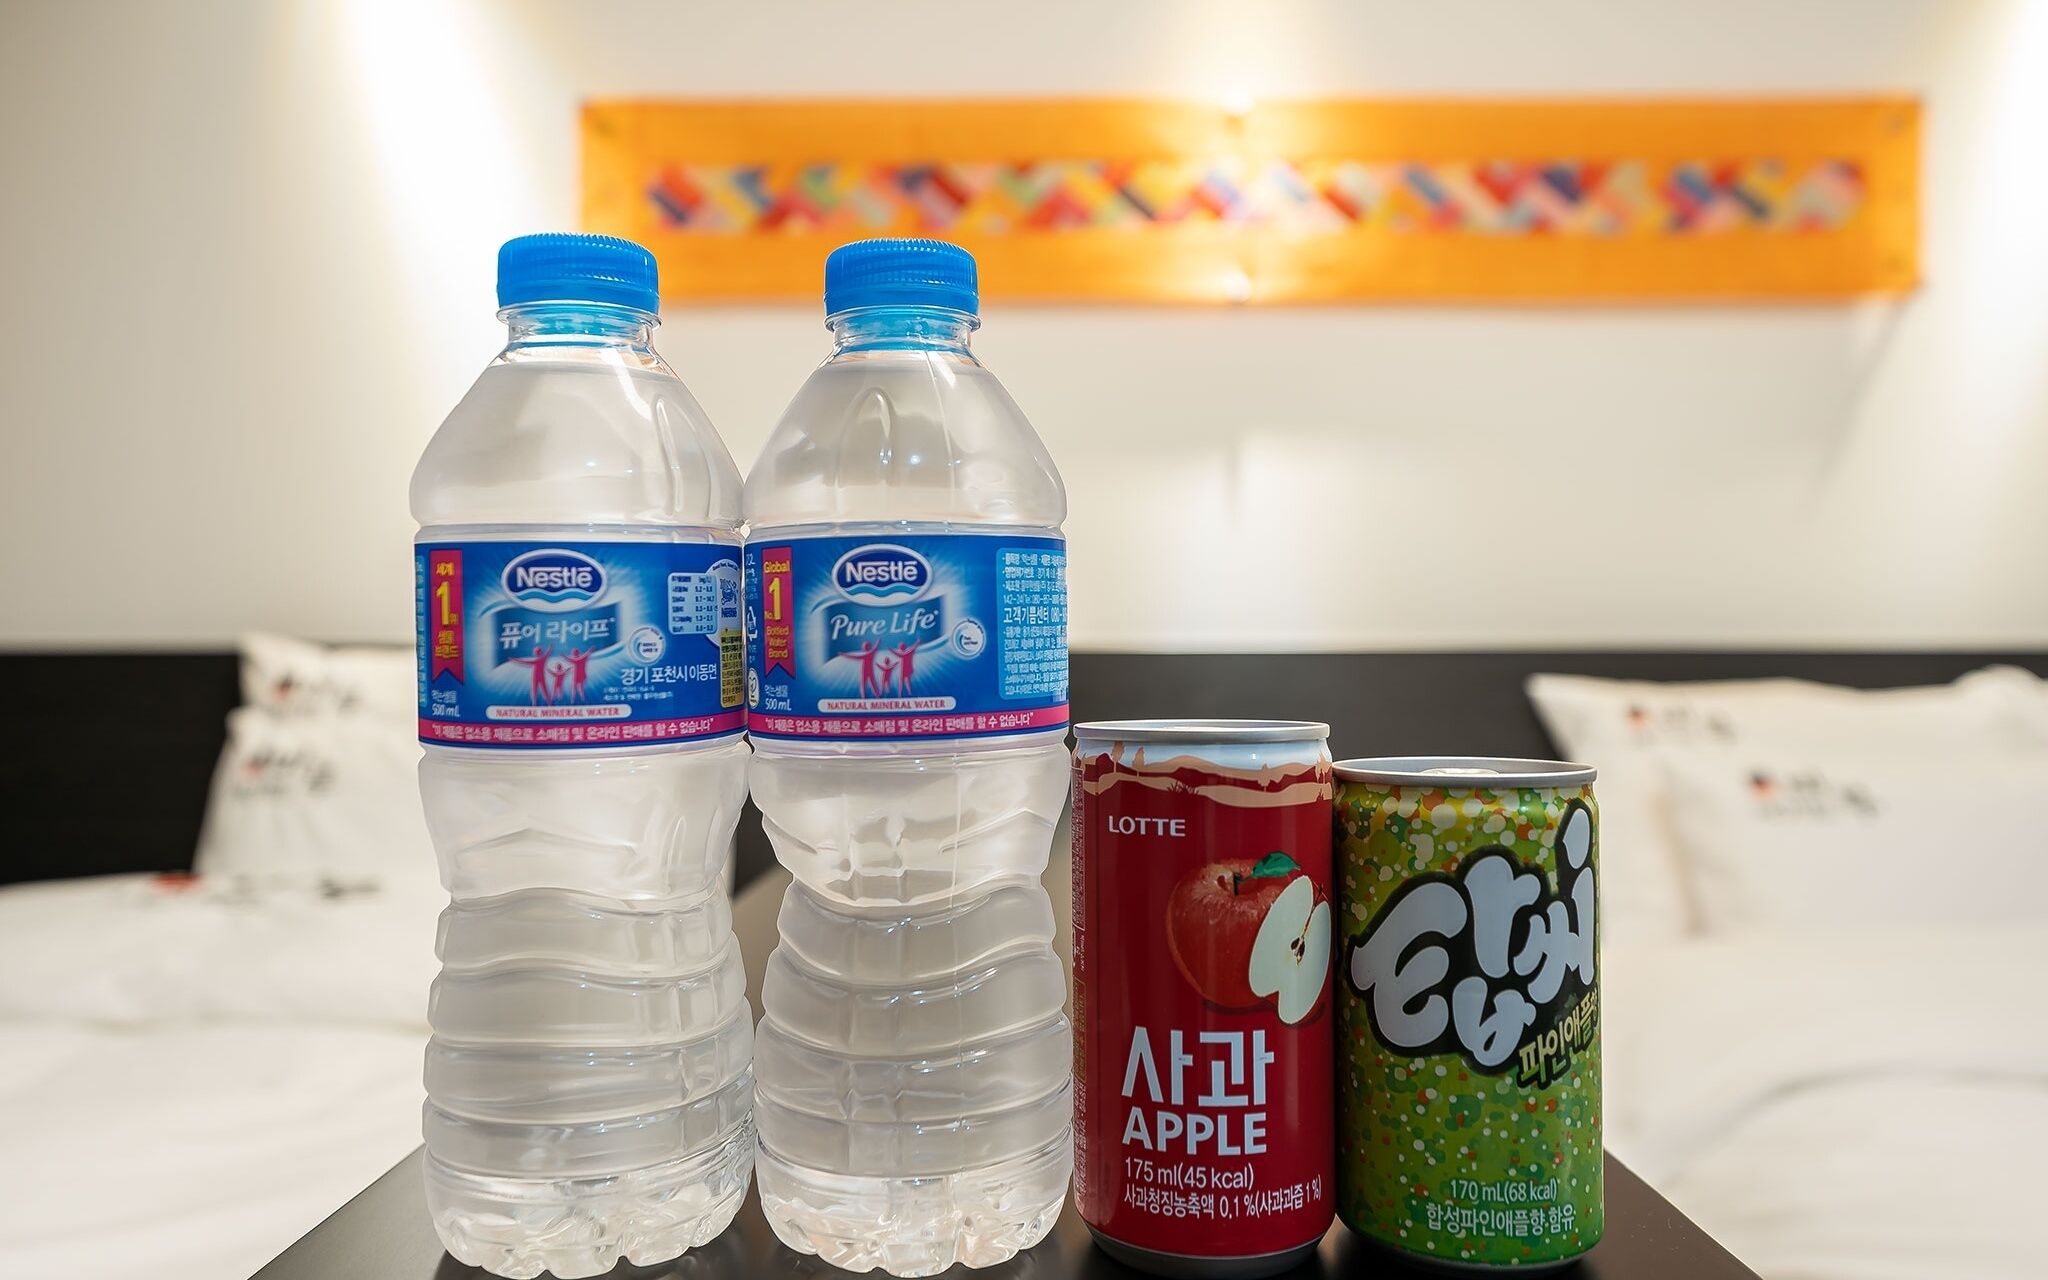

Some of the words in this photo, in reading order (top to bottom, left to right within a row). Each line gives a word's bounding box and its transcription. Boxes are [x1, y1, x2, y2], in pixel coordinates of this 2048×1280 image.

[516, 566, 593, 588] Nestlé
[763, 561, 791, 573] Global
[845, 560, 918, 582] Nestlé
[500, 622, 541, 649] 퓨어
[546, 617, 609, 643] 라이프
[831, 614, 886, 640] Pure
[621, 666, 648, 685] 경기
[651, 665, 687, 683] 포천시
[689, 663, 717, 681] 이동면
[495, 708, 538, 718] NATURAL
[541, 708, 583, 717] MINERAL
[587, 707, 619, 716] WATER
[765, 699, 777, 710] 500
[778, 699, 792, 711] mL
[827, 702, 867, 710] NATURAL
[871, 701, 911, 710] MINERAL
[915, 699, 945, 709] WATER
[536, 727, 569, 741] 소매점
[571, 727, 584, 741] 및
[587, 726, 620, 740] 온라인
[656, 723, 666, 737] 할
[668, 723, 678, 735] 수
[775, 719, 795, 732] 제품은
[795, 720, 820, 734] 업소용
[823, 721, 861, 734] 제품으로
[864, 720, 895, 734] 소매점
[898, 720, 909, 733] 및
[912, 718, 943, 732] 온라인
[946, 717, 975, 731] 판매를
[977, 716, 986, 729] 할
[988, 716, 998, 728] 수
[1108, 815, 1185, 837] LOTTE
[1121, 1026, 1275, 1107] 사과
[1121, 1106, 1267, 1156] APPLE
[1125, 1156, 1153, 1183] 175
[1211, 1162, 1254, 1190] kcal)
[1451, 1179, 1478, 1200] 170
[1529, 1177, 1557, 1201] kcal)
[1124, 1183, 1214, 1219] 사과청징농축액
[1425, 1202, 1545, 1237] 합성파인애플향
[1548, 1204, 1575, 1233] 함유
